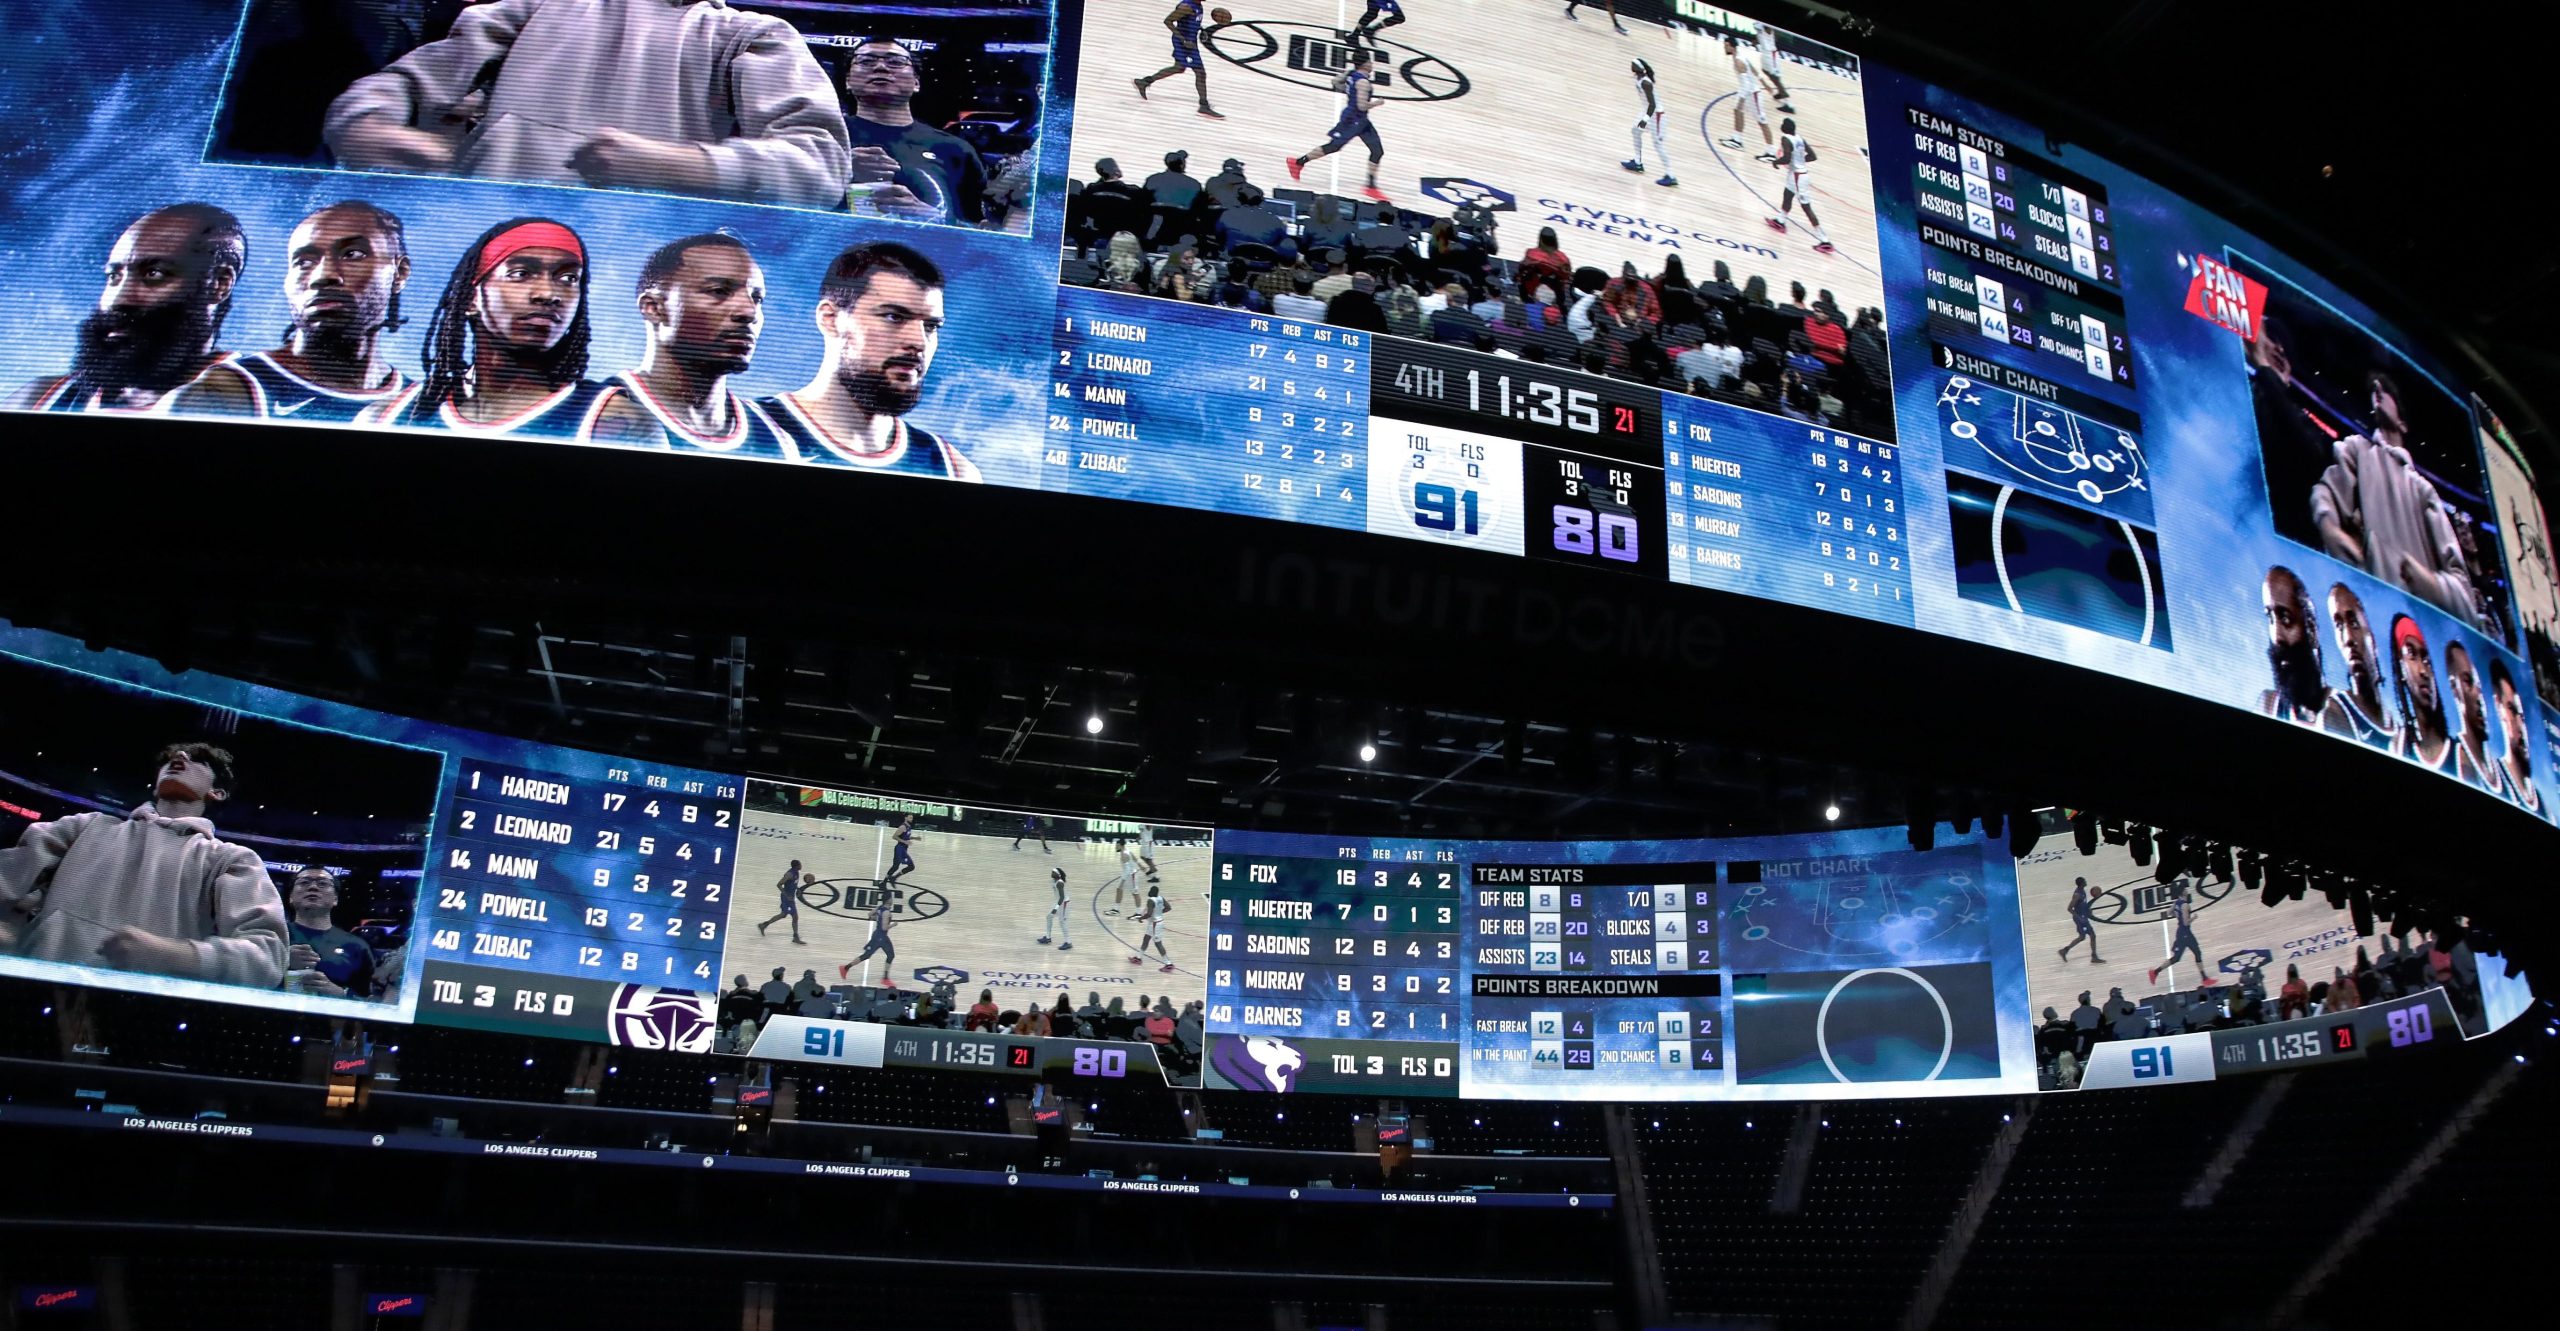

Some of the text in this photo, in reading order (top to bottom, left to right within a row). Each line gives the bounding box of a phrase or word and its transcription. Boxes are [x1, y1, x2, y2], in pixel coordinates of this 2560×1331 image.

[1908, 108, 2004, 157] TEAM STATS
[1537, 198, 1778, 260] crypto.com
[1545, 214, 1682, 249] ARENA
[1923, 226, 2078, 295] POINTS BREAKDOWN
[2202, 258, 2247, 306] FAN
[2201, 290, 2252, 338] CAM
[1090, 320, 1146, 342] HARDEN
[1088, 353, 1151, 376] LEONARD
[1956, 354, 2059, 401] SHOT CHART
[1085, 385, 1126, 406] MANN
[1395, 363, 1635, 434] 4TH 11:35 21
[1082, 418, 1138, 440] POWELL
[1407, 434, 1484, 461] TOL FLS
[1079, 452, 1127, 473] ZUBAC
[1413, 455, 1478, 478] 3 0
[1559, 460, 1632, 488] TOL FLS
[1566, 481, 1628, 505] 3 0
[1414, 481, 1478, 535] 91
[1553, 504, 1638, 563] 80
[471, 771, 626, 811] 1 HARDEN 17
[608, 768, 735, 799] PTS REB AST FLS
[822, 790, 948, 817] NBA Celebrates Black History Month
[461, 811, 620, 849] 2 LEONARD 21
[1339, 847, 1454, 862] PTS REB AST FLS
[450, 849, 610, 887] 14 MANN 9
[1222, 864, 1356, 885] 5 FOX 16
[1477, 868, 1584, 883] TEAM STATS
[1809, 858, 1872, 876] CHART
[439, 889, 608, 927] 24 POWELL 13
[1220, 899, 1351, 920] 9 HUERTER 7
[1480, 891, 1581, 907] OFF REB 8 6
[1627, 891, 1707, 908] T/O 3 8
[1480, 919, 1588, 935] DEF REB 28 20
[1607, 920, 1709, 935] BLOCKS 4 3
[432, 930, 603, 967] 40 ZUBAC 12
[1216, 934, 1354, 955] 10 SABONIS 12
[1478, 948, 1586, 965] ASSISTS 23 14
[1610, 949, 1710, 965] STEALS 6 2
[1215, 970, 1351, 991] 13 MURRAY 9
[1477, 978, 1658, 994] POINTS BREAKDOWN
[433, 979, 463, 1004] TOL
[473, 985, 496, 1007] 3
[514, 990, 547, 1014] FLS
[1210, 1006, 1351, 1027] 40 BARNES 8
[1476, 1020, 1584, 1034] FAST BREAK 12 4
[1619, 1020, 1711, 1034] OFF T/O 10 2
[804, 1026, 1127, 1078] 91 4TH 11:35 21 80
[2131, 1003, 2434, 1080] 91 4TH 11:35 21 80
[1332, 1055, 1358, 1074] TOL
[1367, 1056, 1384, 1075] 3
[1402, 1057, 1427, 1076] FLS
[1473, 1049, 1591, 1063] IN THE PAINT 44 29
[1600, 1049, 1713, 1063] 2ND CHANCE 8 4
[123, 1117, 253, 1136] LOS ANGELES CLIPPERS
[484, 1144, 597, 1159] LOS ANGELES CLIPPERS
[806, 1164, 910, 1178] LOS ANGELES CLIPPERS
[1103, 1181, 1200, 1193] LOS ANGELES CLIPPERS
[1381, 1193, 1477, 1203] LOS ANGELES CLIPPERS
[378, 1298, 412, 1311] Clippers
